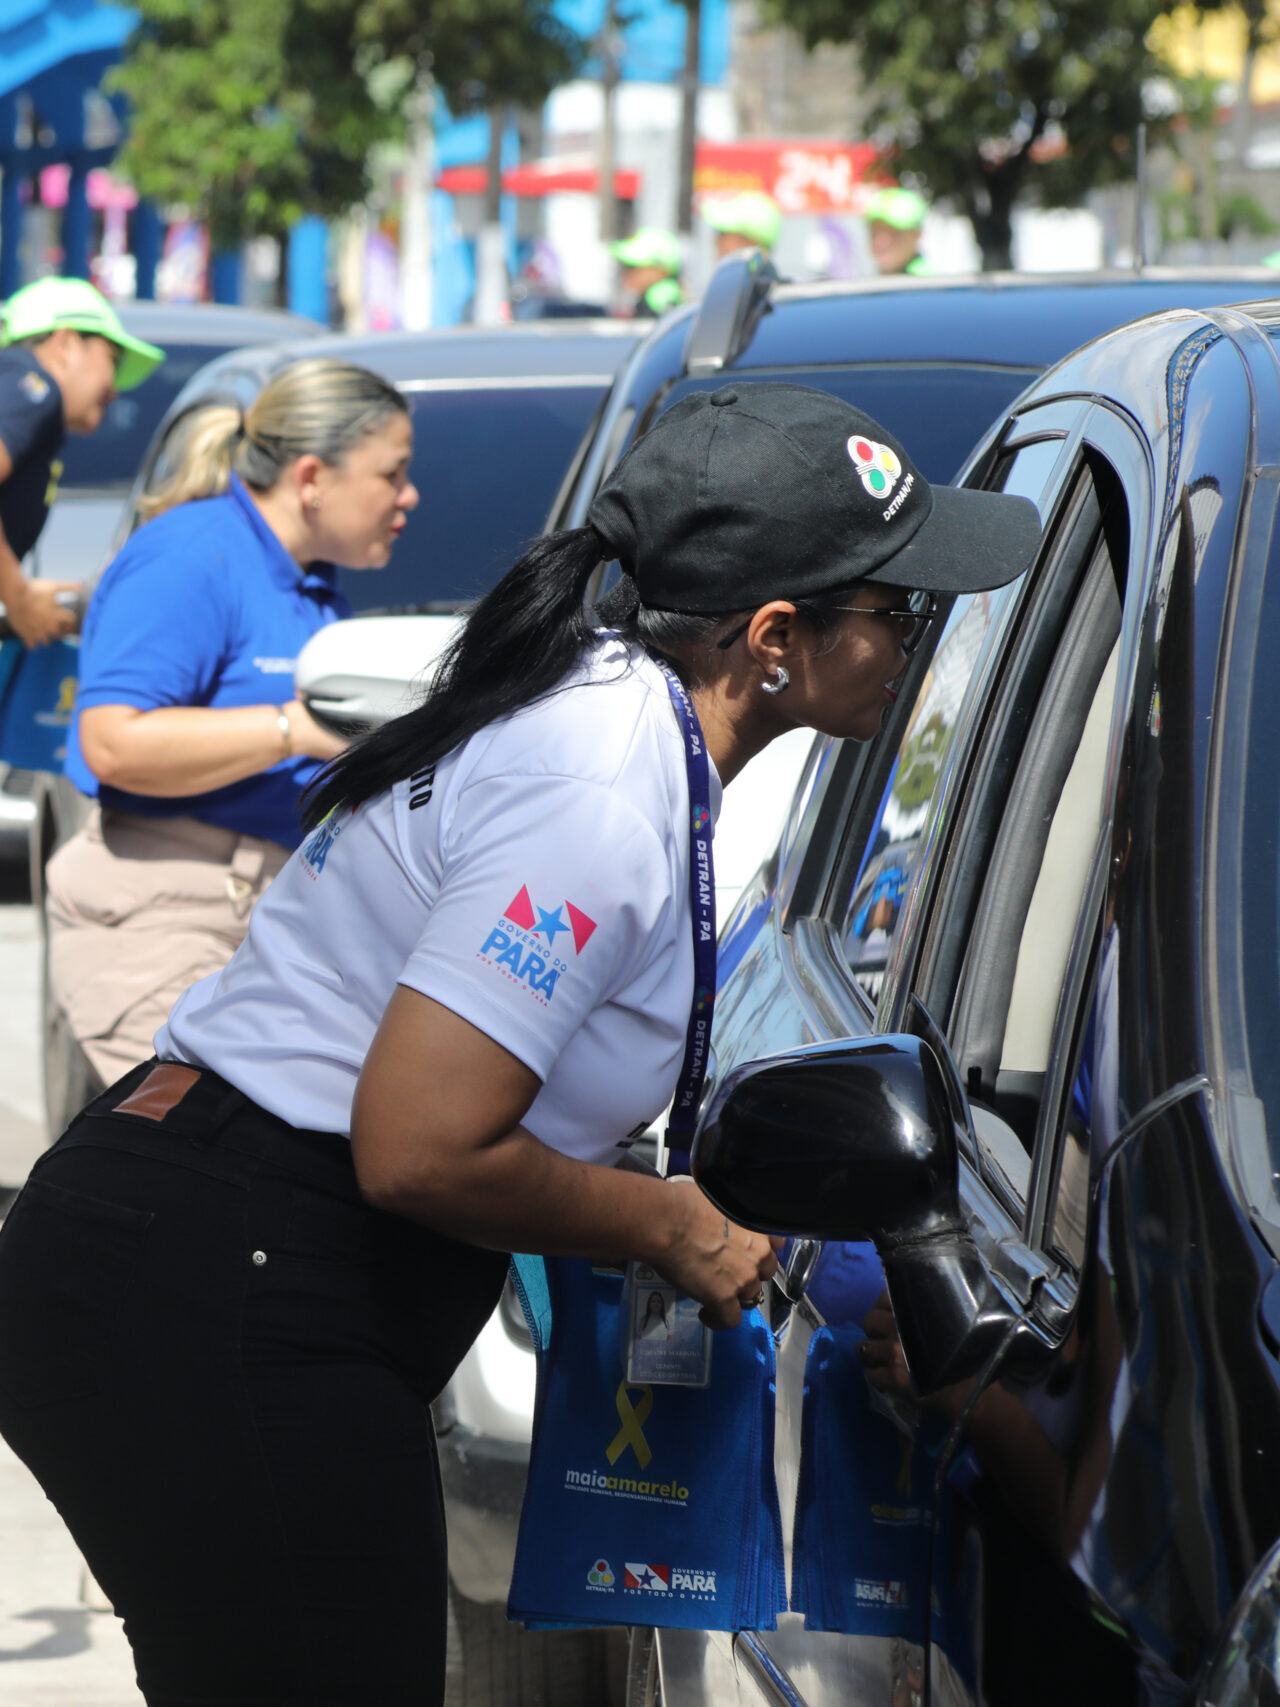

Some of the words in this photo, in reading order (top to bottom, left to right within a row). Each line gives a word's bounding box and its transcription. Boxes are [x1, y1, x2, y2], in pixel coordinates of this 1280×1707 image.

[690, 734, 702, 755] PA
[696, 839, 711, 906] DETRAN
[700, 921, 711, 941] PA
[497, 919, 551, 959] GOVERNO
[553, 957, 567, 972] DO
[690, 1019, 707, 1078] DETRAN
[680, 1090, 694, 1107] PA
[566, 1469, 689, 1499] maioamarelo
[672, 1567, 705, 1576] GOVERNO
[623, 1588, 642, 1596] POR
[648, 1590, 674, 1599] TODO
